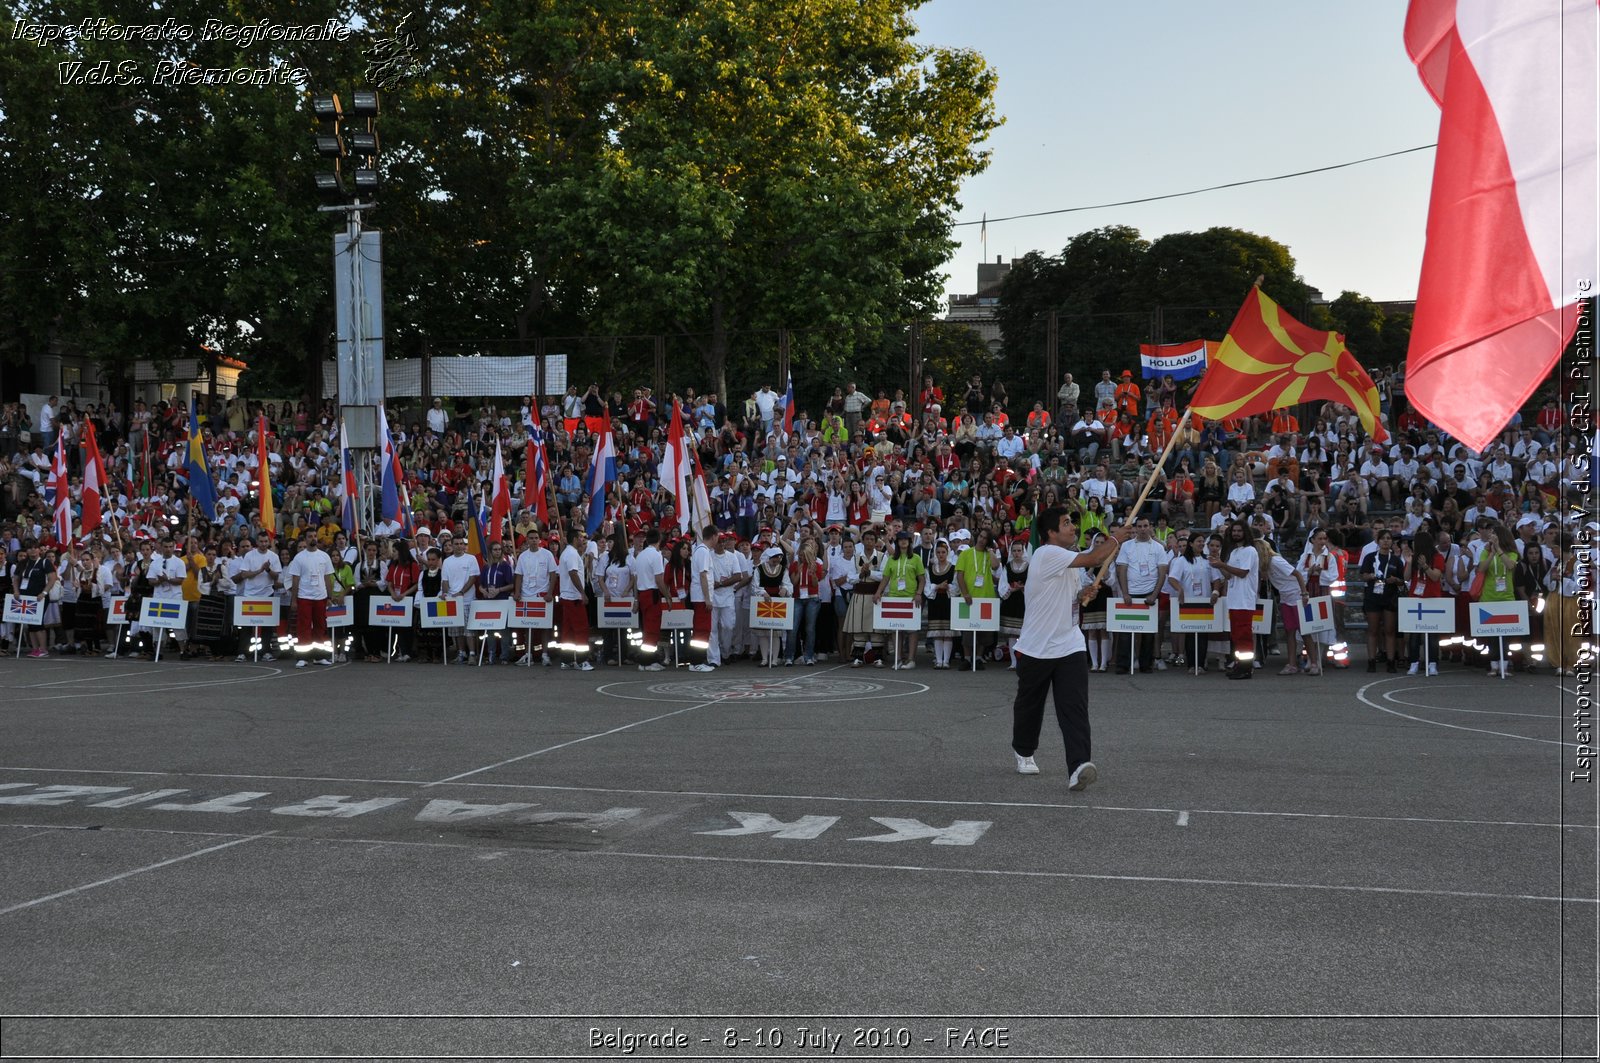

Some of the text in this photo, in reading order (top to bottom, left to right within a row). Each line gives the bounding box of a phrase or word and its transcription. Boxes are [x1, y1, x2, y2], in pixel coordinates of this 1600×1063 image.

[1149, 354, 1197, 367] HOLLAND
[1496, 625, 1525, 635] Republic
[0, 782, 646, 824] PARTIZ
